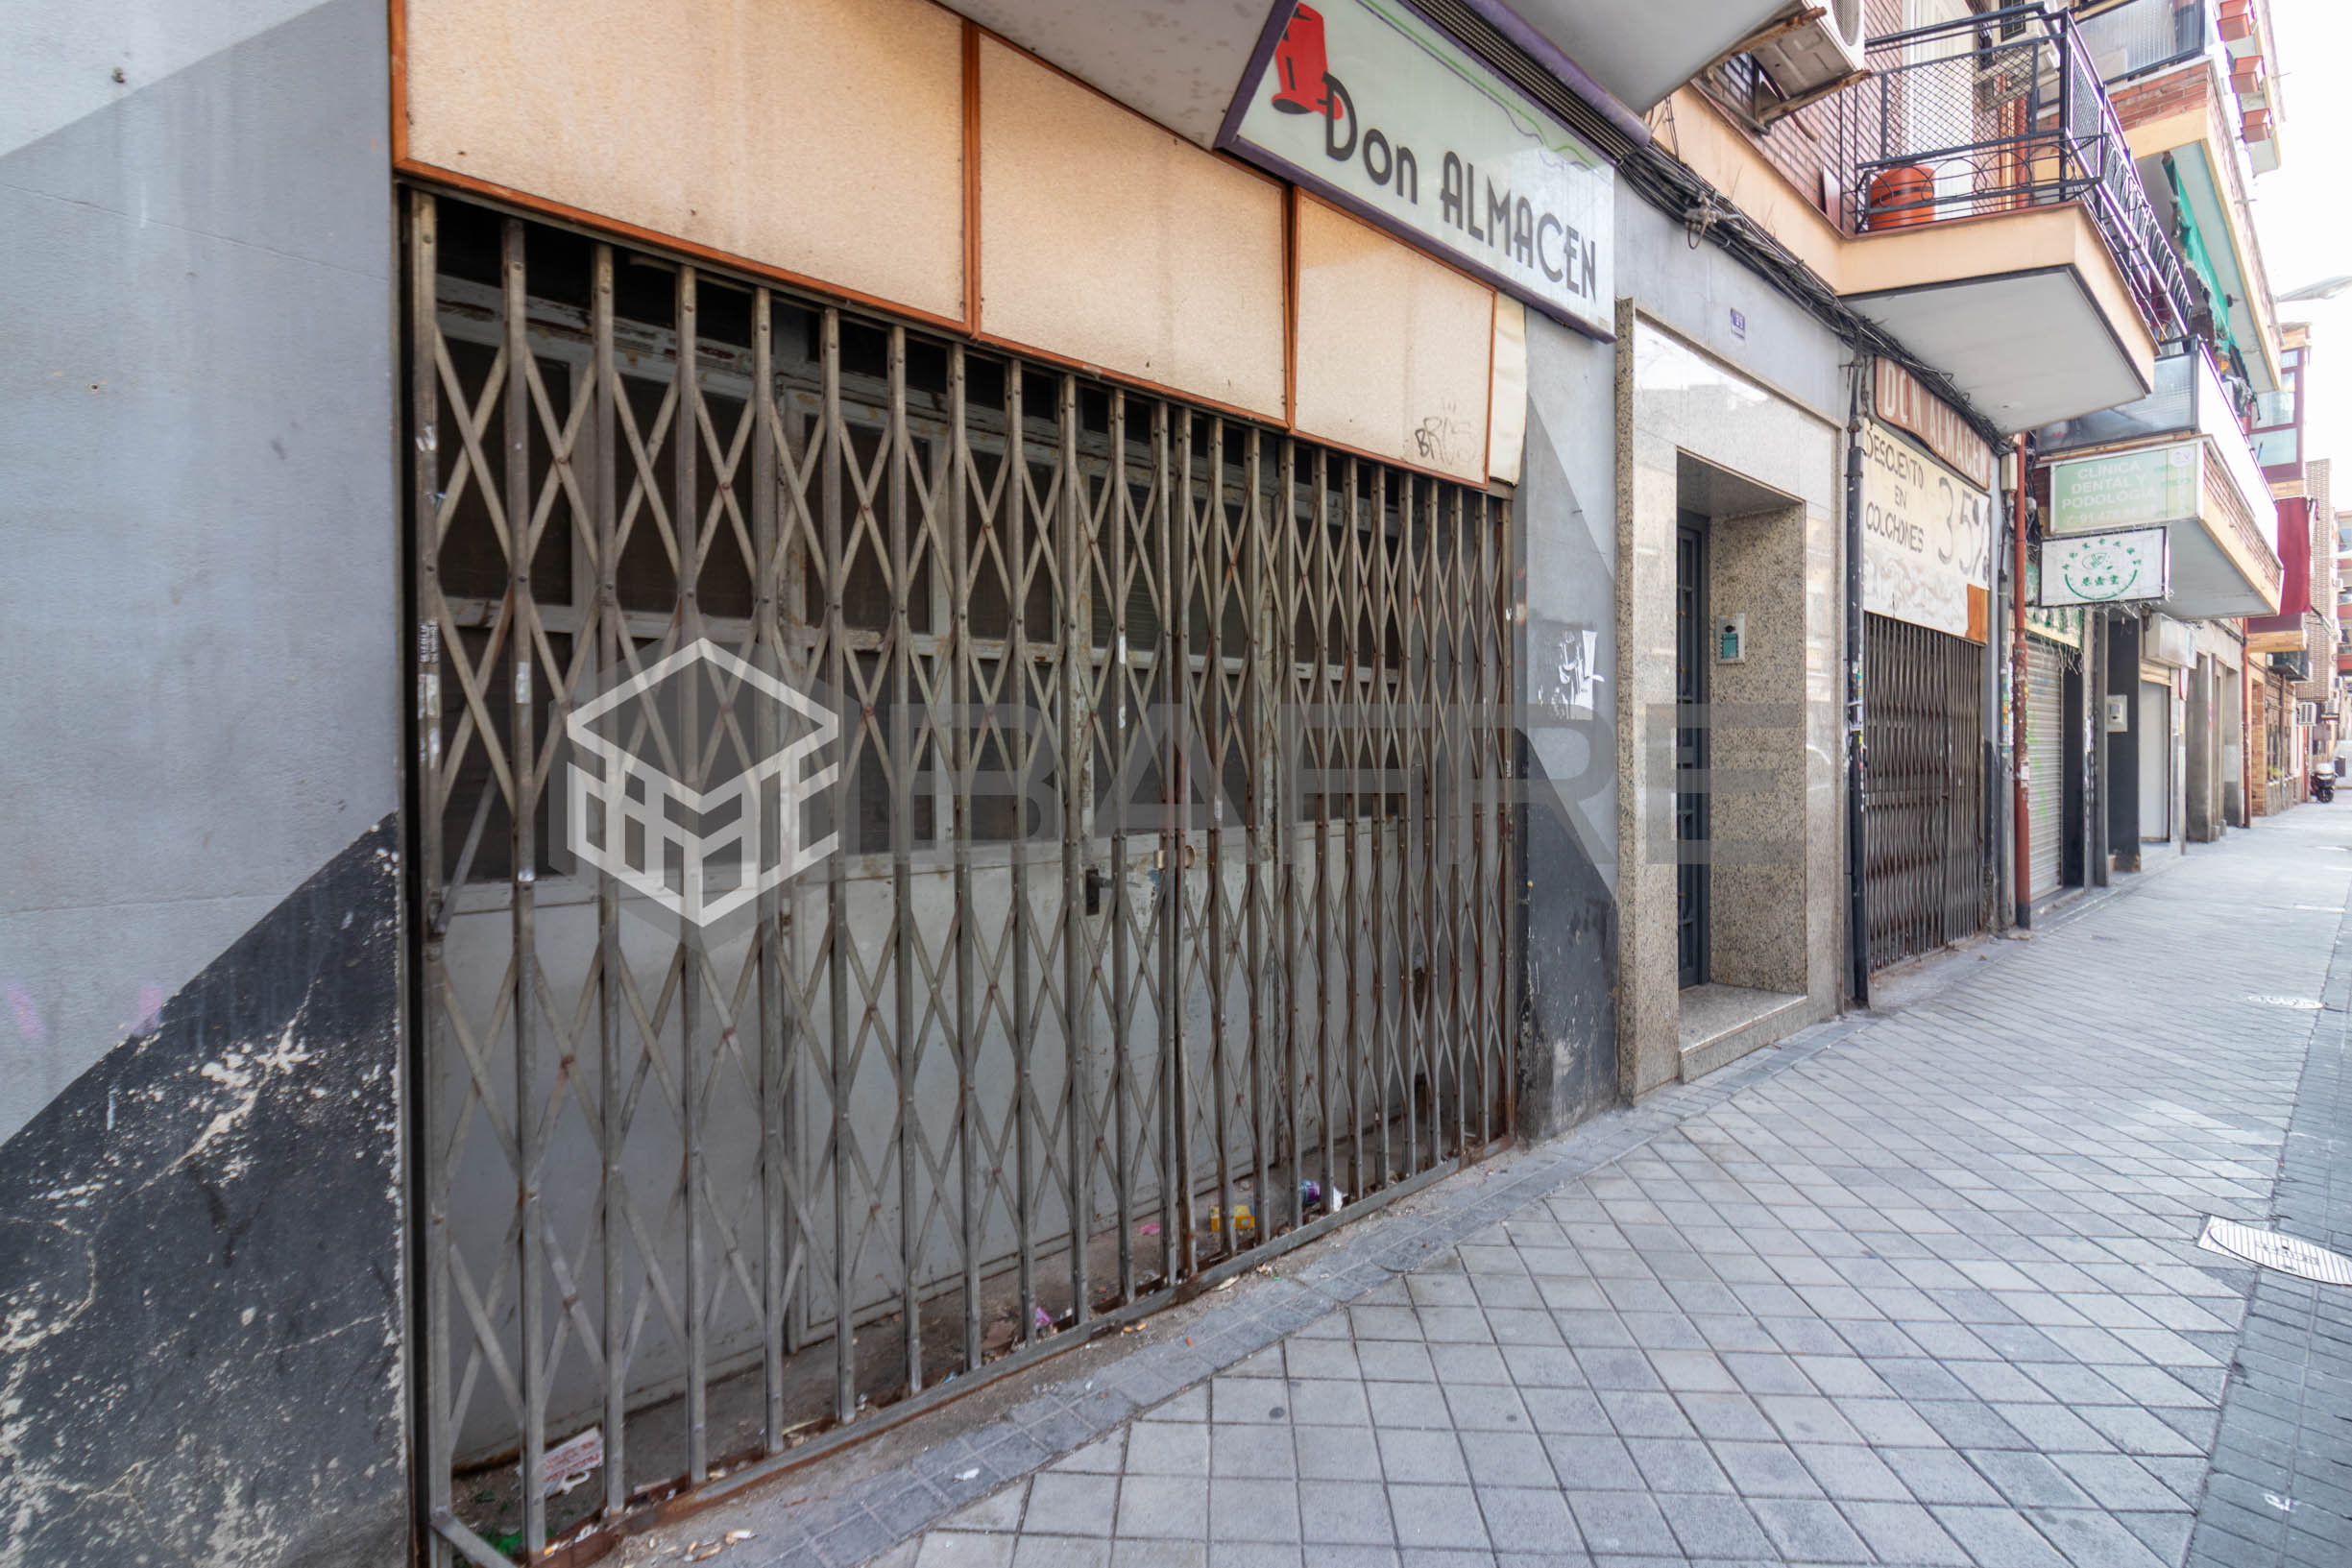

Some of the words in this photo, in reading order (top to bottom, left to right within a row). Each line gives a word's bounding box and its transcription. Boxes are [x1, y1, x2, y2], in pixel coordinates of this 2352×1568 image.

[1322, 71, 1418, 205] Don
[1440, 150, 1598, 302] ALMACEN
[1894, 486, 1907, 510] EN
[2072, 475, 2130, 494] DENTAL
[2136, 473, 2146, 485] Y
[1865, 501, 1925, 553] COLCHONES
[1937, 476, 1990, 582] 35%
